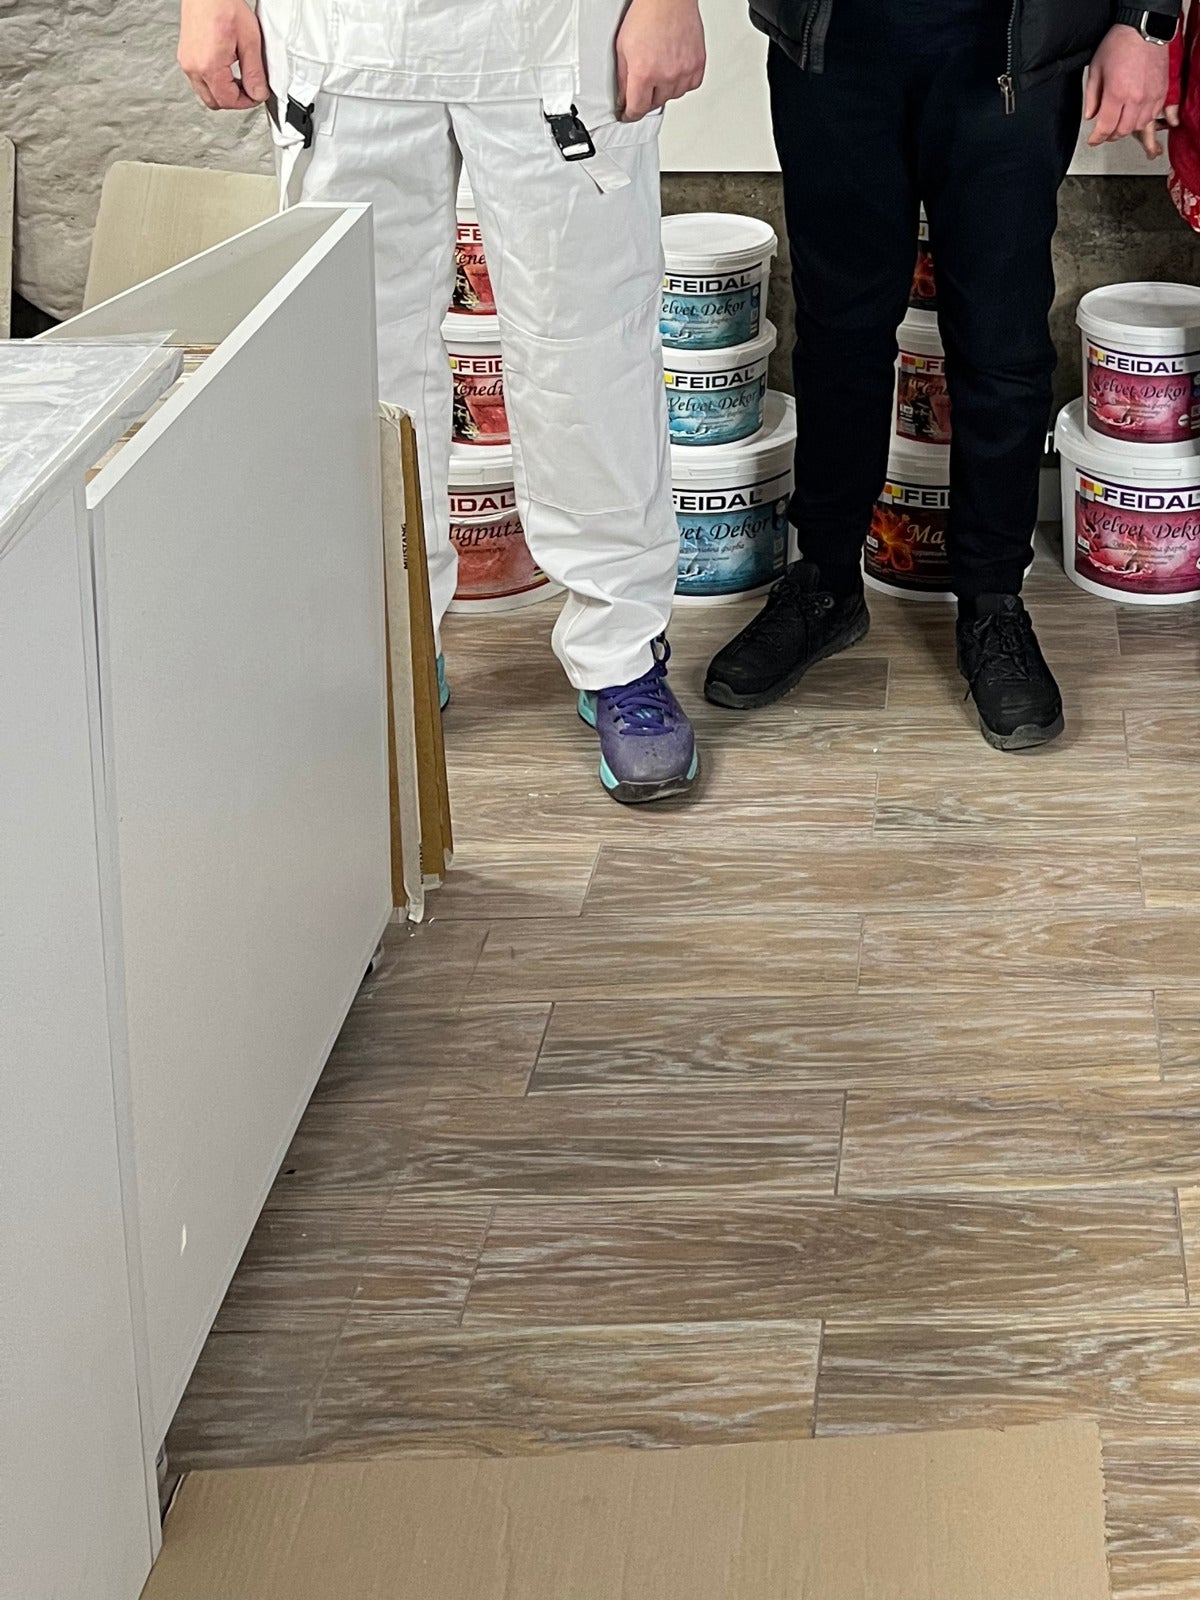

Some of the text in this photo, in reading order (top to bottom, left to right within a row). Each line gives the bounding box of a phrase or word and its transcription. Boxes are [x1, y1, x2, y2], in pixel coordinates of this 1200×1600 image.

[669, 275, 751, 294] FEIDAL
[661, 297, 747, 317] elvet Dekor
[458, 360, 503, 373] FEID
[1105, 354, 1184, 374] FEIDAL
[675, 369, 755, 389] FEIDAL
[669, 389, 759, 413] Velvet Dekor
[1140, 383, 1187, 402] Dekor
[450, 495, 516, 512] IDAL
[904, 488, 949, 506] FEI
[709, 515, 770, 540] Dekor
[1090, 510, 1144, 538] Velvet
